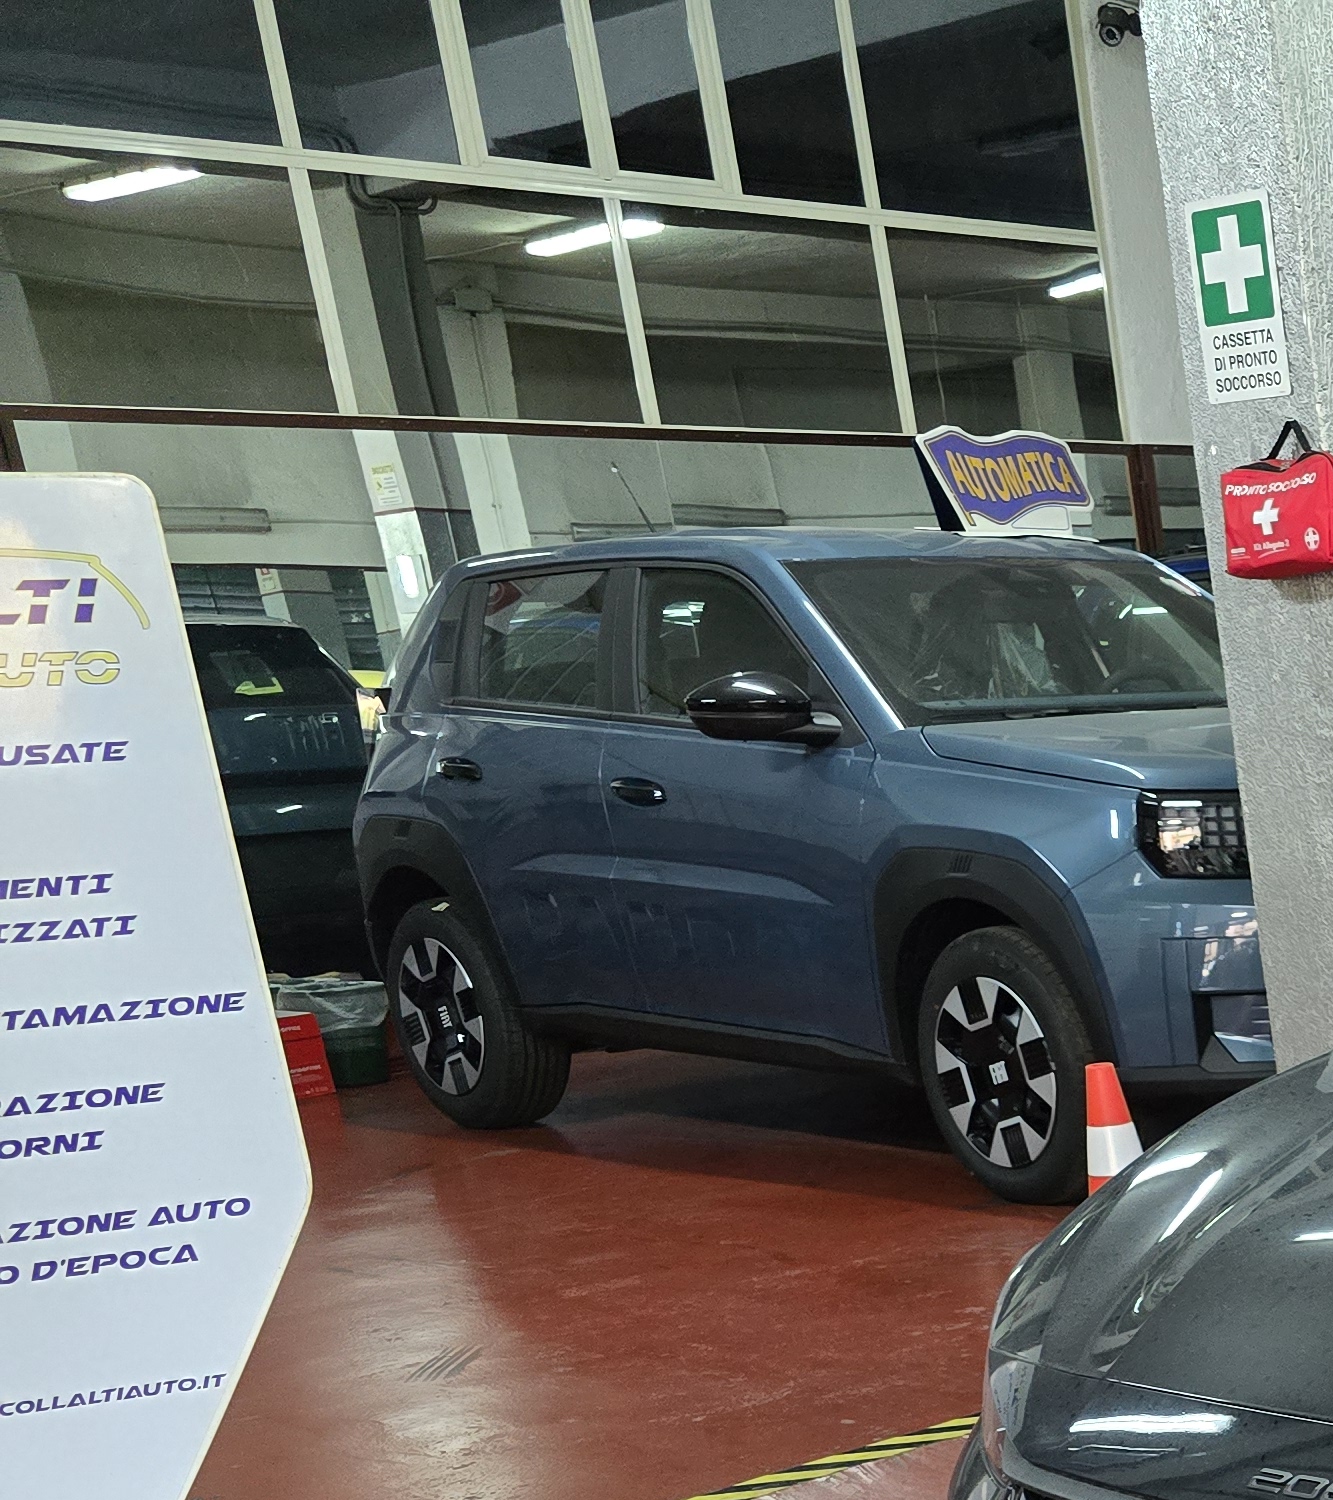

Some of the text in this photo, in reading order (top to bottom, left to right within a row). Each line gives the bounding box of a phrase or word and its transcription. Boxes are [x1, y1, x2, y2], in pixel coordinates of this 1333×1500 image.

[1213, 328, 1275, 350] CASSETTA
[1214, 350, 1278, 371] DI PRONTO
[1216, 371, 1282, 393] SOCCORSO
[945, 450, 1081, 502] AUTOMATICA
[0, 740, 129, 767] USATE
[437, 1005, 453, 1028] FIAT
[147, 1197, 251, 1227] AUTO
[31, 1243, 199, 1281] D'EPOCA
[0, 1372, 227, 1417] COLLALTIAUTO.IT
